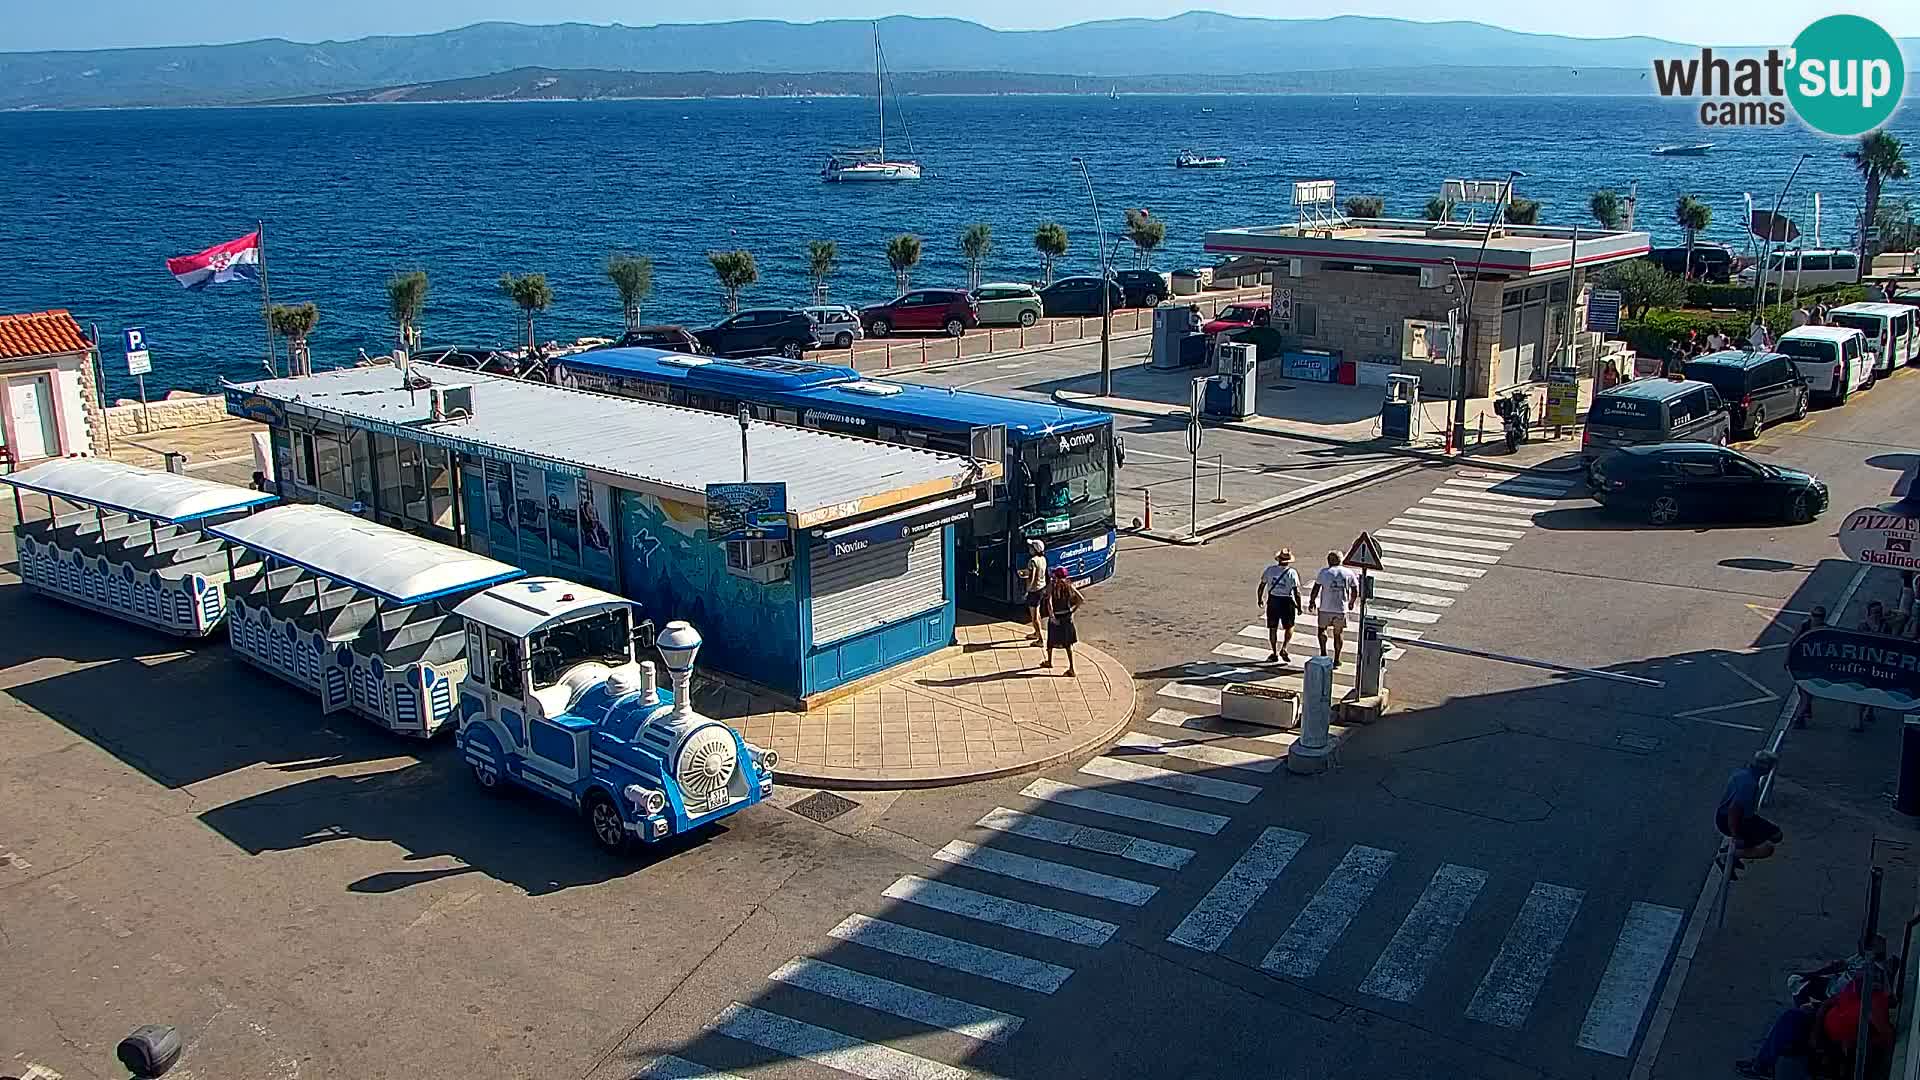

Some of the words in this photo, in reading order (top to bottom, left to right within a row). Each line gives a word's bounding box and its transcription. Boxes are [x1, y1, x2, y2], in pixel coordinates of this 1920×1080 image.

[129, 331, 142, 350] P
[1616, 401, 1637, 410] TAXI
[1069, 433, 1095, 447] arriva
[395, 428, 435, 444] AUTOBUSNA
[437, 437, 467, 452] POSTAJA
[478, 447, 493, 457] BUS
[494, 450, 526, 464] STATION
[528, 457, 554, 471] TICKET
[555, 463, 582, 477] OFFICE
[1849, 515, 1920, 531] PIZZE
[1883, 531, 1918, 540] GRILL
[1802, 642, 1920, 672] MARINER
[1829, 662, 1866, 673] caffe
[1871, 666, 1897, 679] bar
